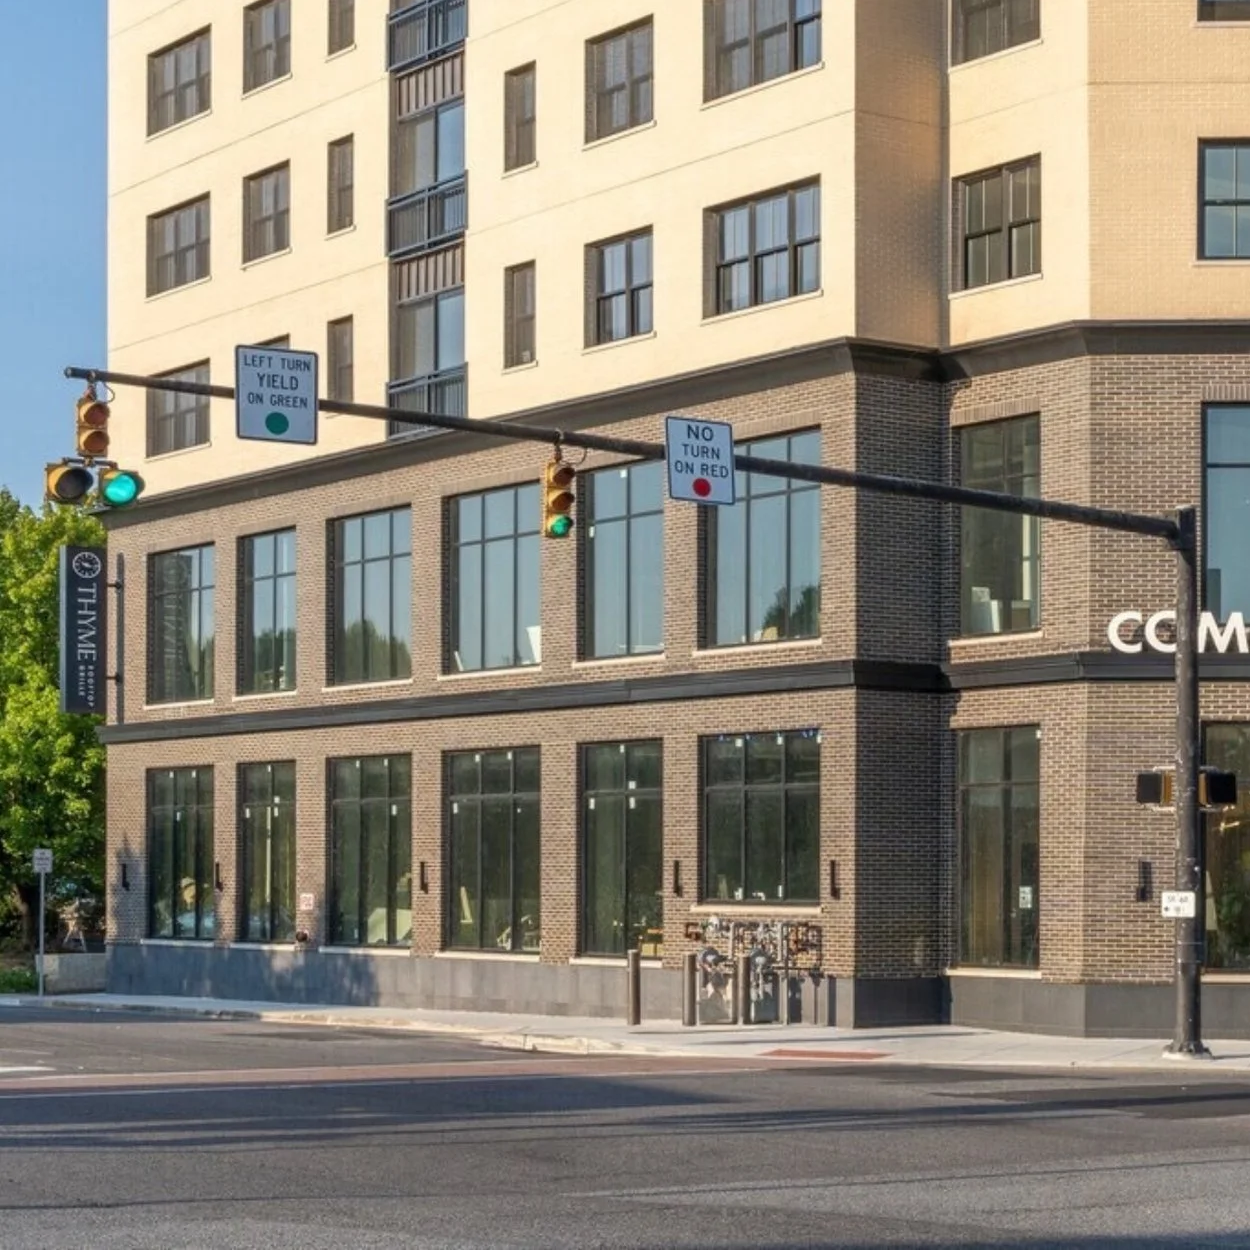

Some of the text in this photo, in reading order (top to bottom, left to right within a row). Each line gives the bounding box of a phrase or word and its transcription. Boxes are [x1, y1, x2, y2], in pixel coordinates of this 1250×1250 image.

[244, 354, 311, 371] LEFT TURN
[257, 373, 299, 390] YIELD
[247, 392, 308, 409] ON GREEN
[687, 424, 714, 441] NO
[682, 443, 720, 460] TURN
[674, 460, 729, 478] ON RED
[77, 583, 97, 661] THYME
